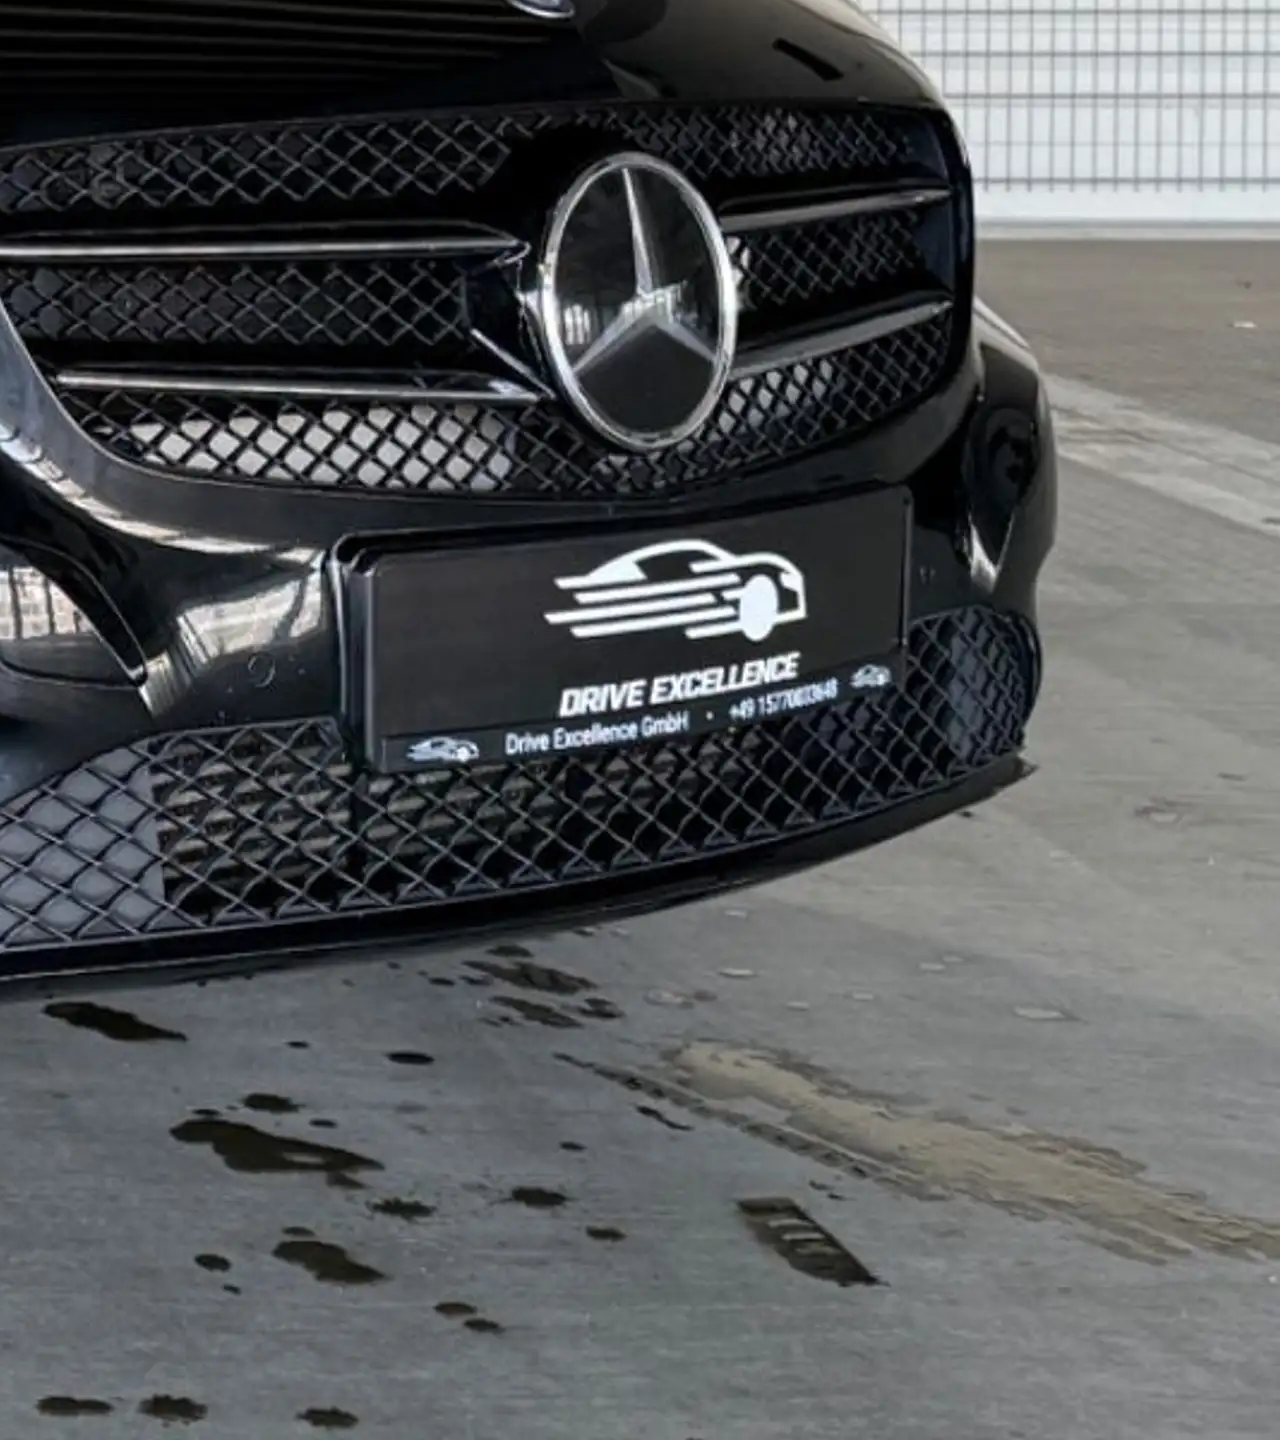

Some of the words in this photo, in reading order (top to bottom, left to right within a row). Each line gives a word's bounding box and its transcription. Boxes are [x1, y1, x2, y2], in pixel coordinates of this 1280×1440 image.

[559, 678, 647, 718] DRIVE
[650, 650, 801, 705] EXCELLENCE
[504, 731, 550, 755] Drive
[553, 720, 638, 750] Excellence
[641, 710, 689, 737] GmbH
